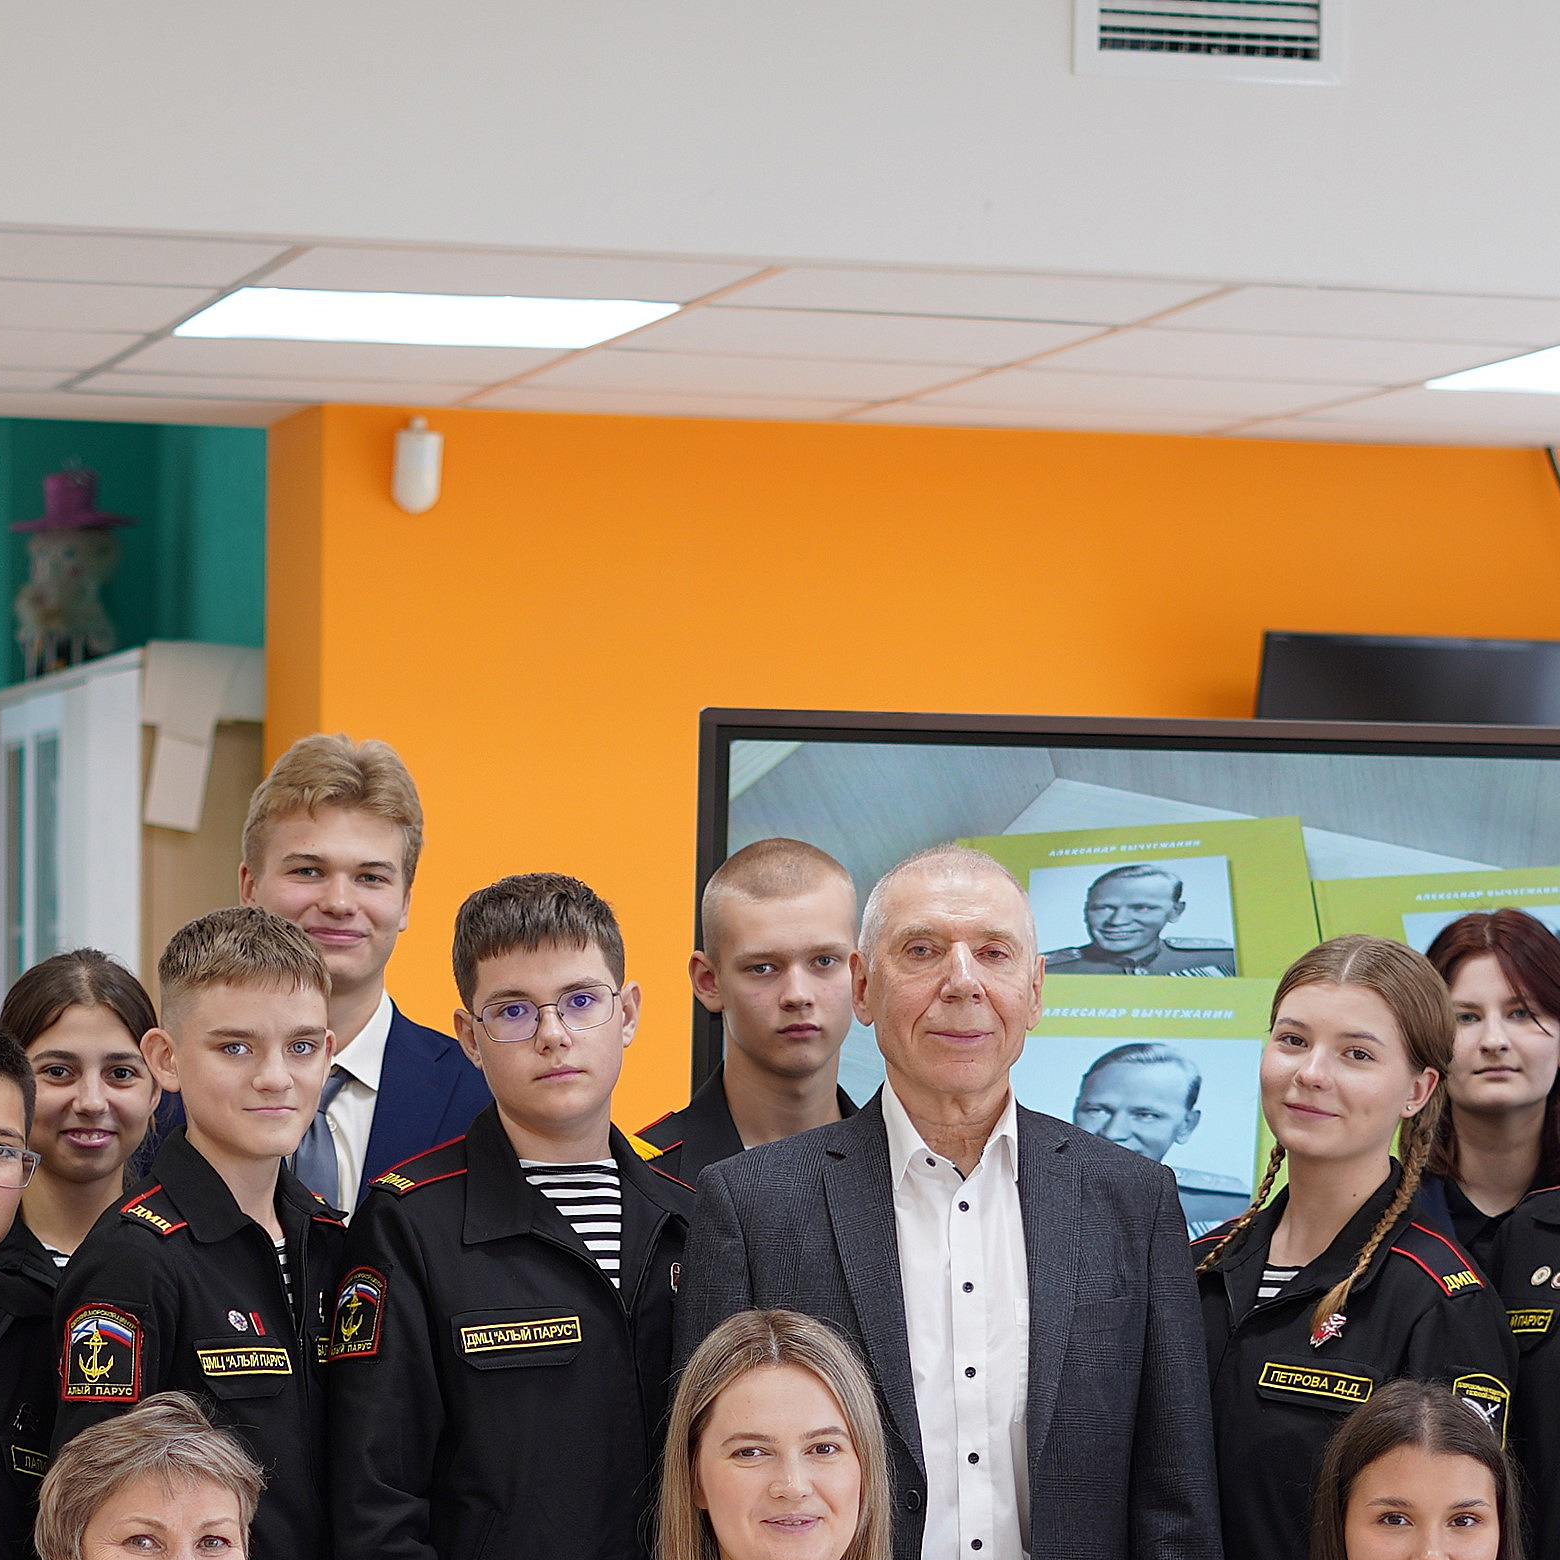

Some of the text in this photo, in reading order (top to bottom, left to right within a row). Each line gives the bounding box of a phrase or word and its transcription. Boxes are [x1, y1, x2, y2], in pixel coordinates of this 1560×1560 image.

[1048, 844, 1117, 858] АЛЕКСАНДР
[1042, 1007, 1128, 1020] АЛЕКСАНДР
[127, 1204, 173, 1232] ДМЦ
[1442, 1270, 1482, 1293] ДМЦ
[466, 1331, 495, 1348] ДМЦ
[347, 1342, 373, 1353] ПАРУС
[202, 1356, 226, 1371] ДМЦ
[94, 1386, 133, 1396] ПАРУС
[1270, 1370, 1362, 1398] ПЕТРОВА Д.Д.
